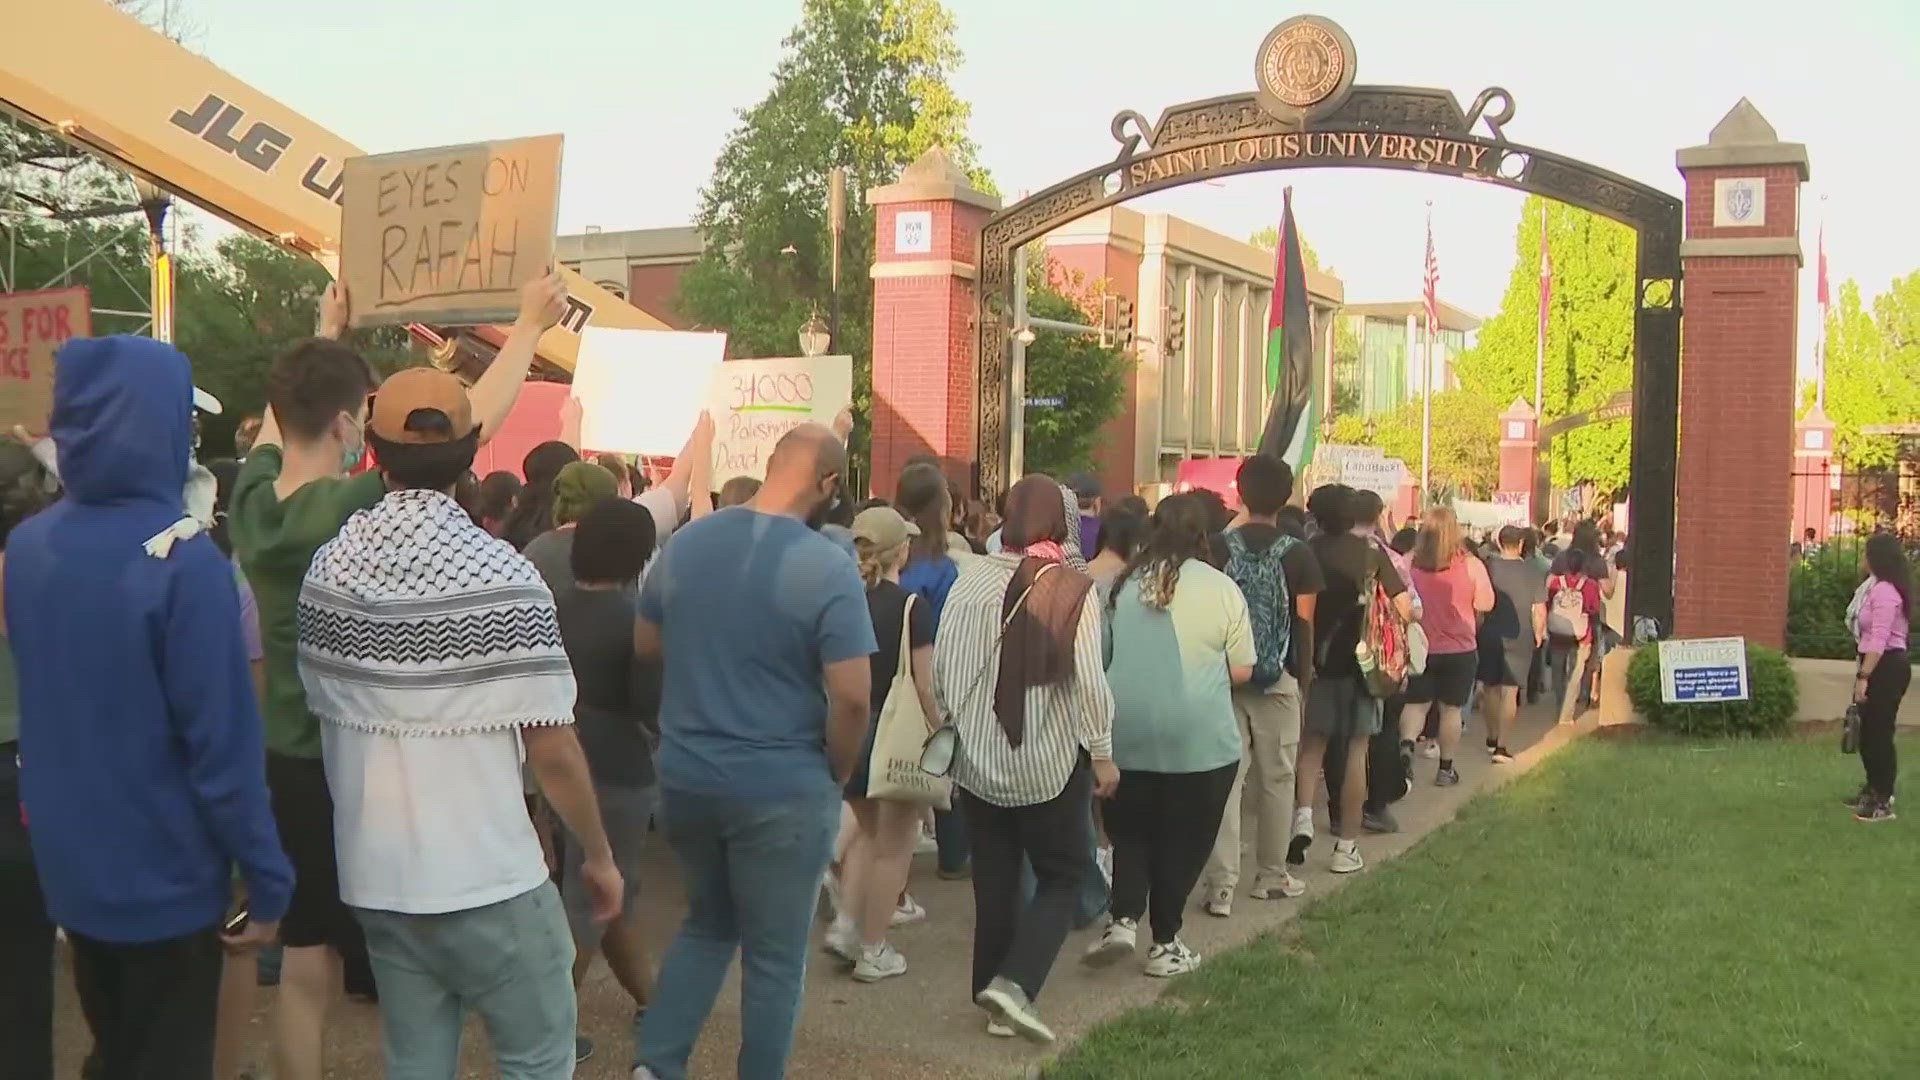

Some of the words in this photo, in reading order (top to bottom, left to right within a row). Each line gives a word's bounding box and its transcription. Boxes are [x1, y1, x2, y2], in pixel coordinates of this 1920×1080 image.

[169, 93, 293, 173] JLG
[1130, 150, 1212, 187] SAINT
[1219, 134, 1301, 166] LOUIS
[1304, 132, 1490, 170] UNIVERSITY
[377, 159, 462, 217] EYES
[482, 157, 530, 197] ON
[379, 218, 519, 300] RAFAH
[22, 303, 72, 344] FOR
[730, 372, 814, 410] 34000
